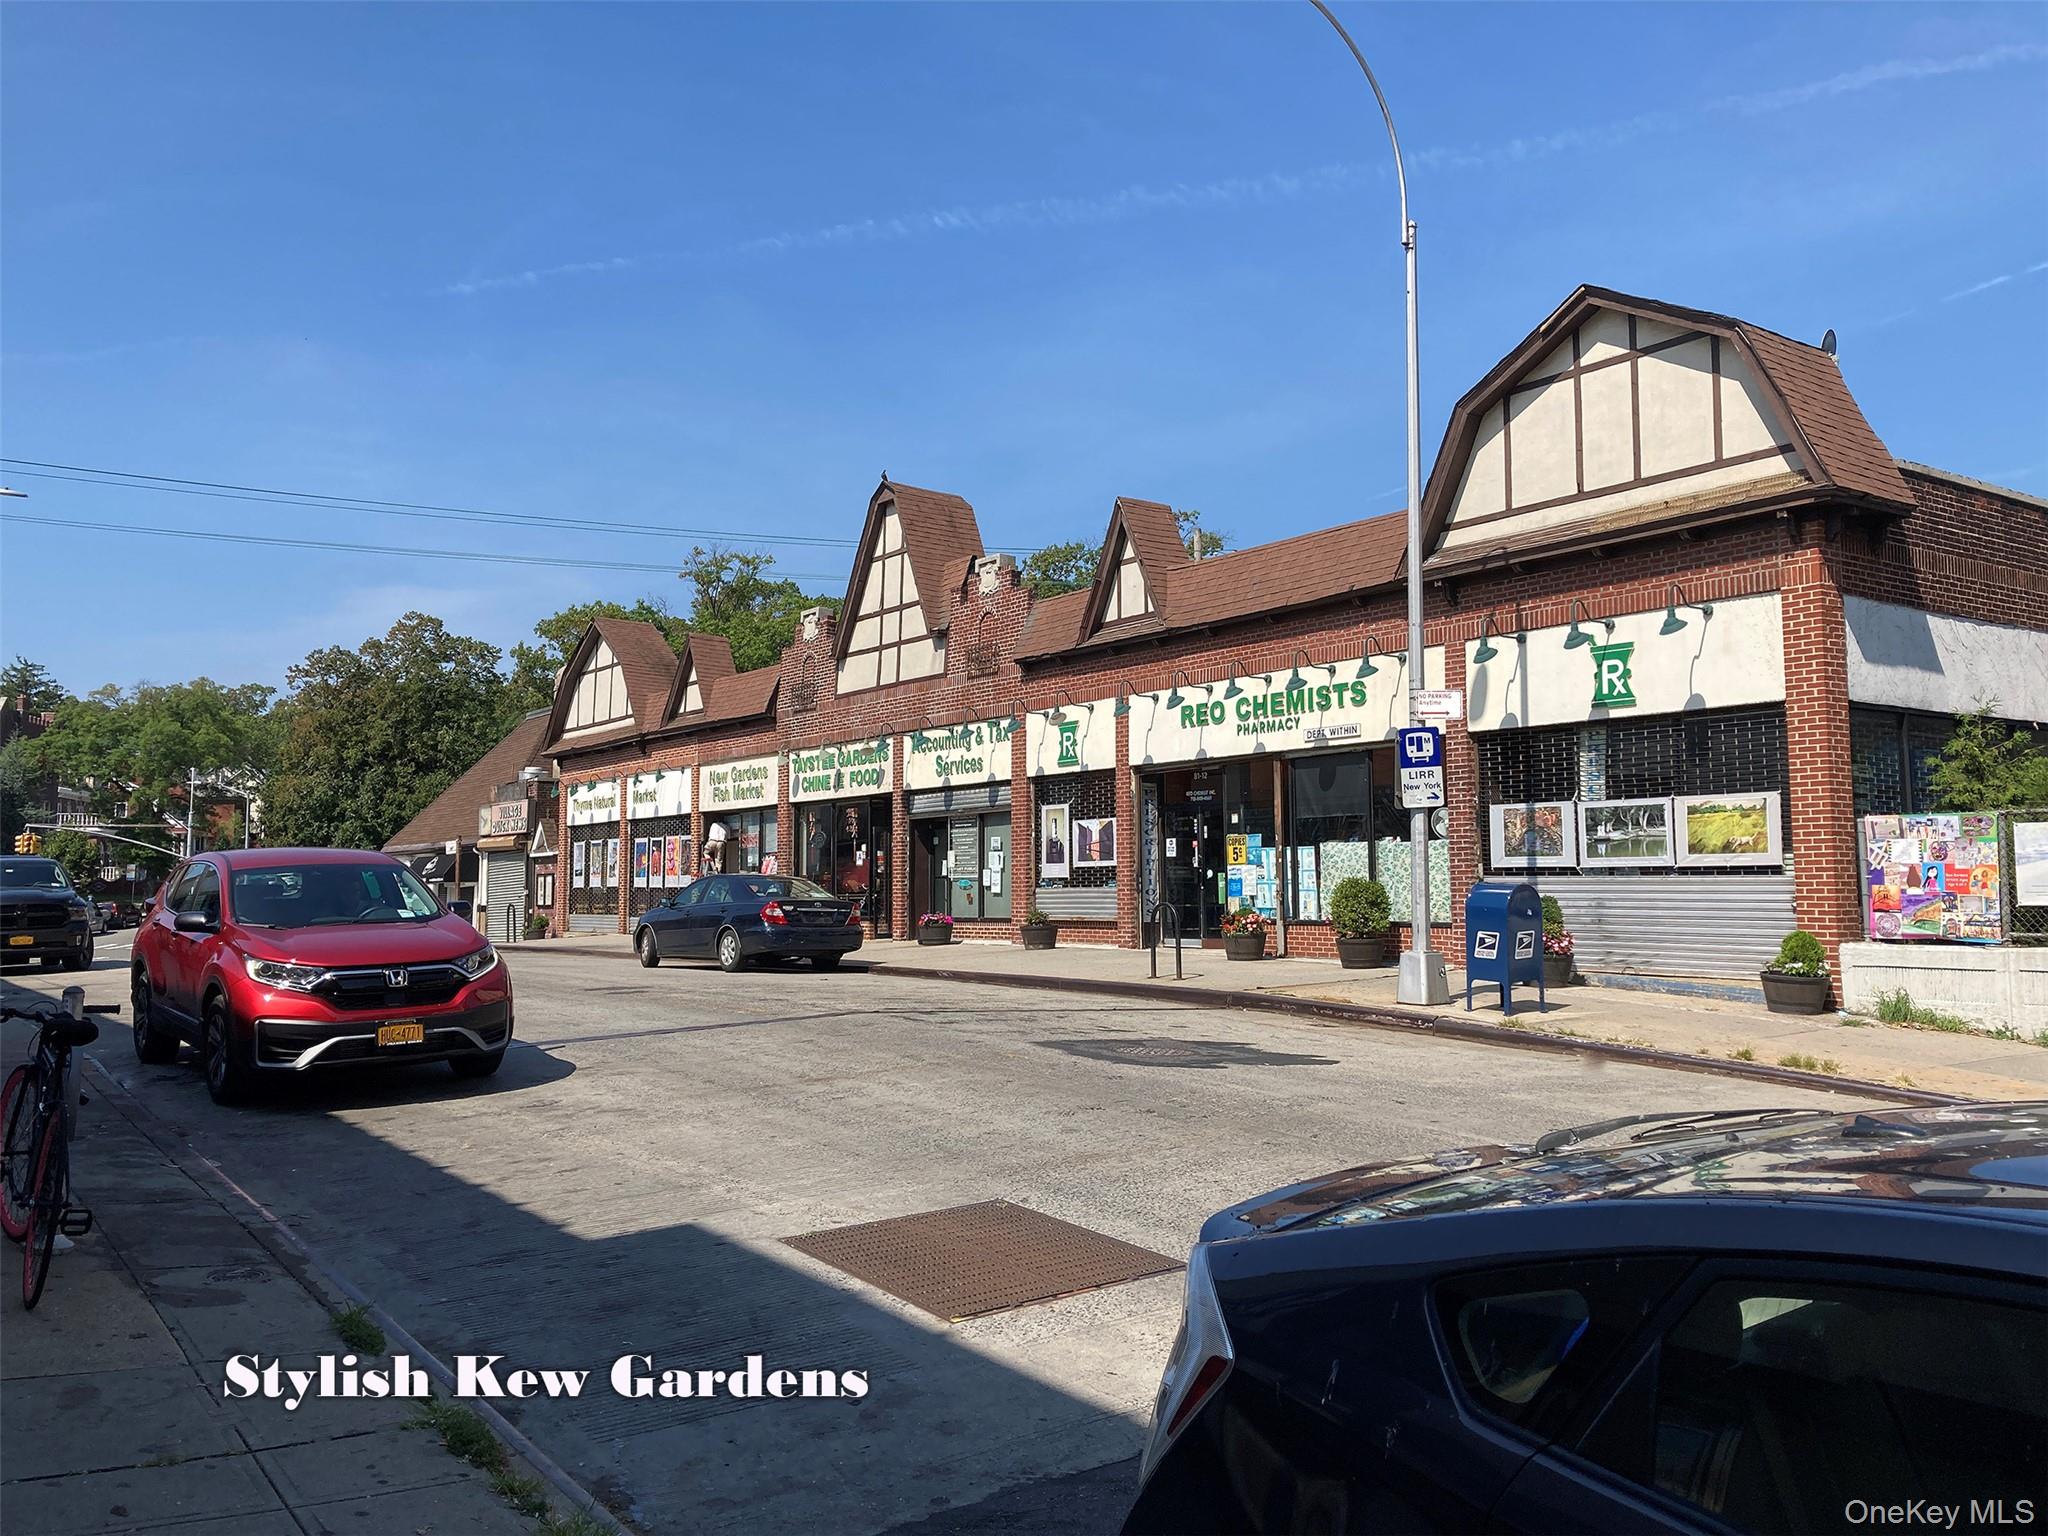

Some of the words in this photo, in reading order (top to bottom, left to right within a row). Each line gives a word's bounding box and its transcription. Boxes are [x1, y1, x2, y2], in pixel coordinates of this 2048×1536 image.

[1181, 701, 1226, 729] REO
[1236, 681, 1367, 722] CHEMISTS
[975, 726, 984, 745] &
[988, 720, 1010, 743] Tax
[1237, 717, 1300, 736] PHARMACY
[1329, 726, 1358, 736] WITHIN
[792, 753, 836, 774] TAYSTEE
[936, 754, 983, 777] Services
[731, 764, 769, 783] Gardens
[802, 772, 844, 793] CHINEE
[849, 768, 880, 788] FOOD
[1409, 770, 1435, 780] LIRR
[713, 786, 731, 803] Fish
[733, 782, 764, 800] Market
[1404, 783, 1421, 791] New
[1424, 781, 1442, 790] York
[593, 794, 617, 811] Natural
[632, 788, 657, 804] Market
